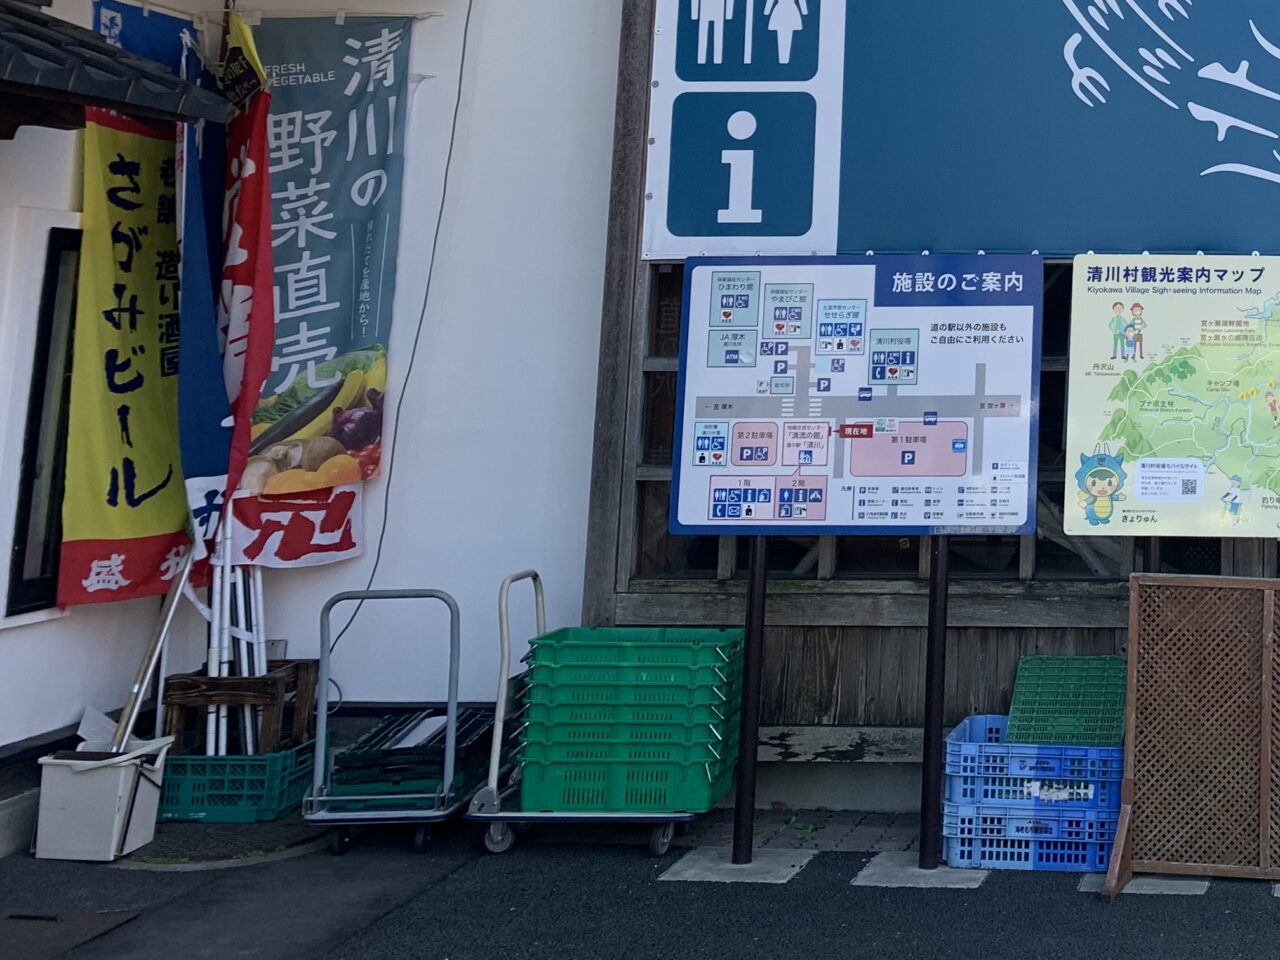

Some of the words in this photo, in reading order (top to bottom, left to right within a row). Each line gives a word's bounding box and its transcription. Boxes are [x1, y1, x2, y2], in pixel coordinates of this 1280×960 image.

[265, 63, 305, 75] FRESH
[343, 27, 404, 207] 清川の
[266, 109, 344, 392] 野菜直売
[1087, 266, 1266, 283] 清川村観光案内マップ
[892, 272, 1024, 292] 施設のご案内
[718, 283, 754, 291] ひまわり館
[1087, 286, 1123, 294] Kiyokawa
[1125, 286, 1150, 294] Village
[1245, 287, 1262, 295] Map
[771, 295, 807, 303] やまびこ館
[824, 311, 860, 319] せせらぎ館
[104, 153, 173, 508] さがみビール
[930, 323, 1007, 332] 道の駅以外の施設も
[876, 337, 912, 346] 清川村役場
[930, 335, 1025, 344] ご自由にご利用ください
[1092, 363, 1114, 371] 丹沢山
